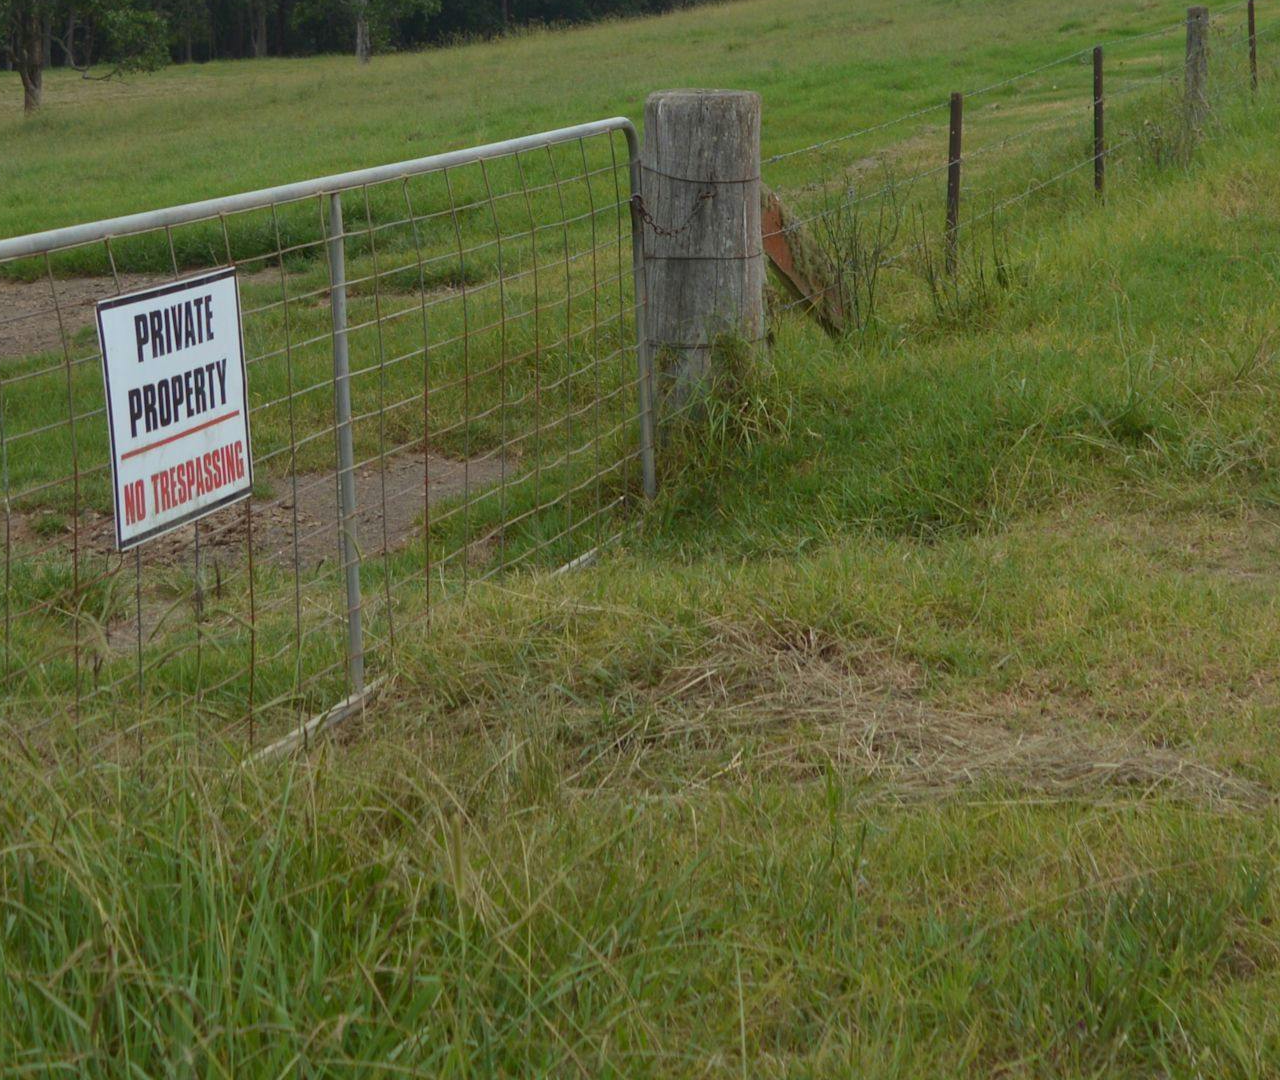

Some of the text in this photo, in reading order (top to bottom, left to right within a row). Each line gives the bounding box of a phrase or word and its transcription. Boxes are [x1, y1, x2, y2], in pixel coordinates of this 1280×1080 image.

[134, 295, 214, 362] PRIVATE
[128, 358, 227, 438] PROPERTY
[124, 440, 245, 526] NO TRESPASSING
